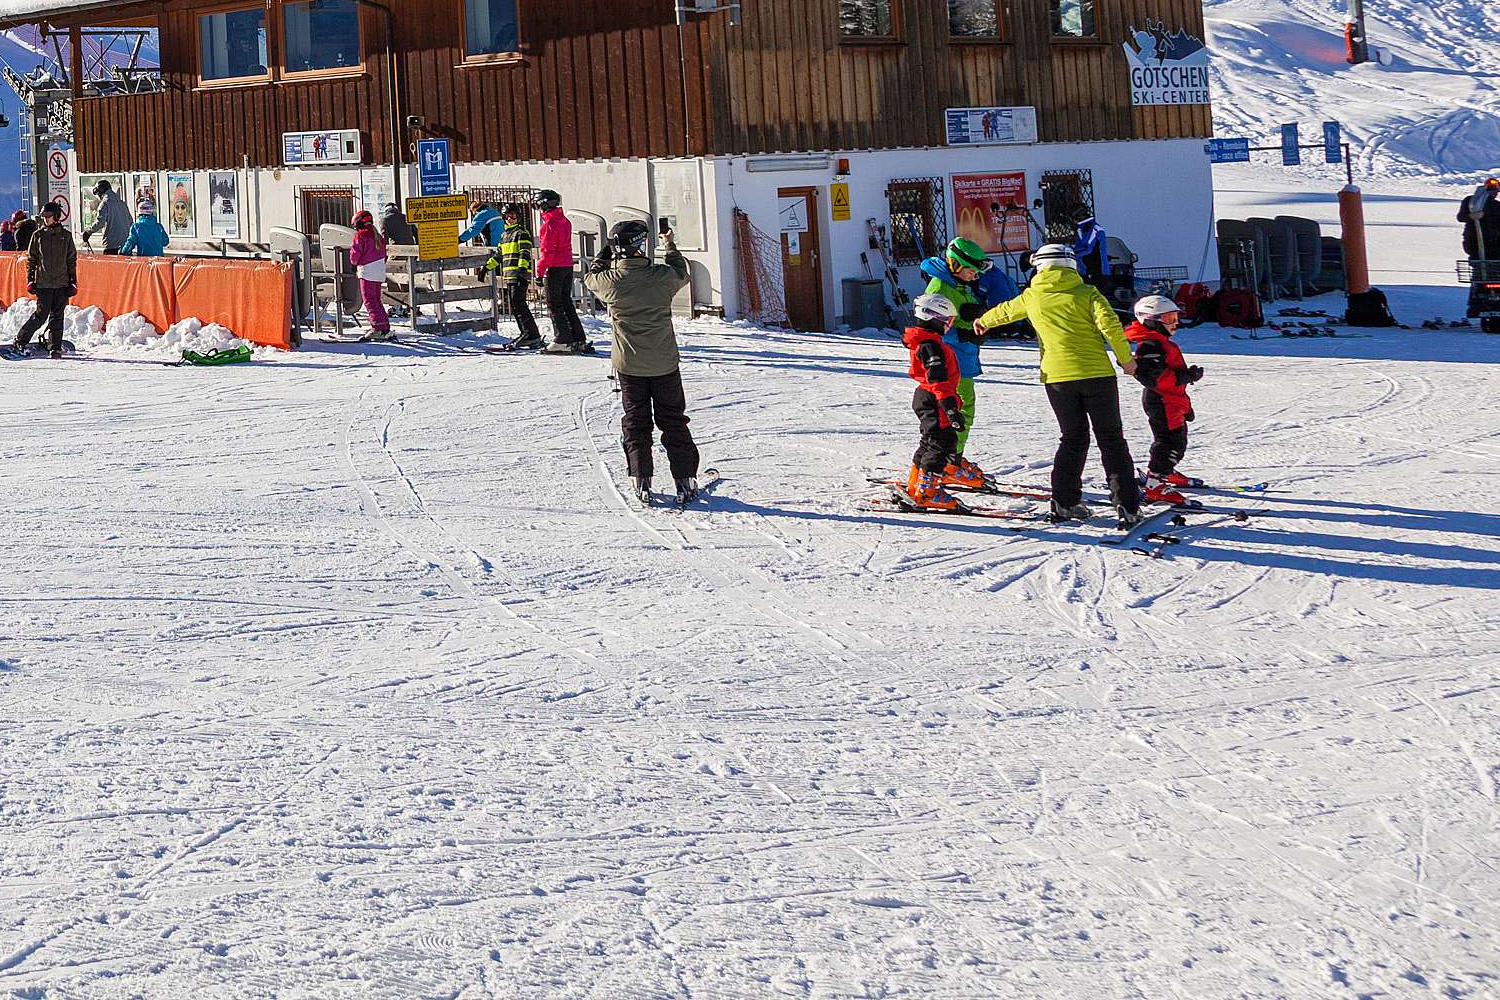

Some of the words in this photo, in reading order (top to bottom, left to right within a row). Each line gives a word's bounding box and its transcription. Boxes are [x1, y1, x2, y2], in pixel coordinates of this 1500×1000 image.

[1132, 64, 1209, 89] GÖTSCHEN
[981, 178, 1001, 187] GRATIS
[409, 199, 424, 211] Bügel
[425, 199, 439, 209] nicht
[440, 197, 465, 208] zwischen
[413, 211, 422, 220] die
[423, 210, 439, 219] Beine
[440, 209, 463, 219] nehmen
